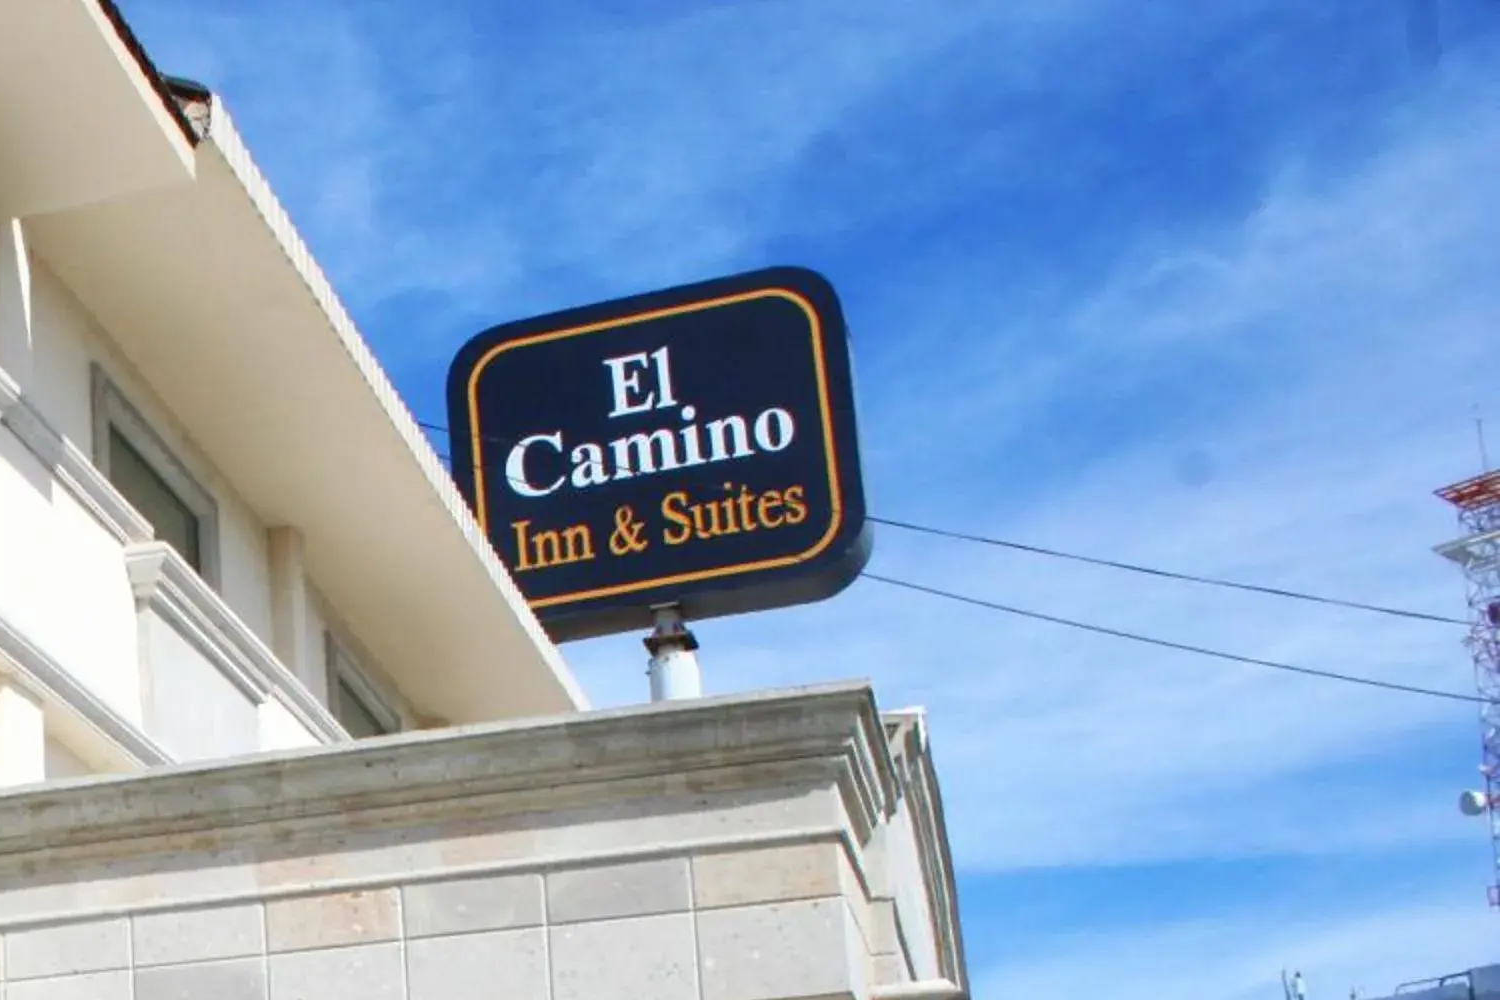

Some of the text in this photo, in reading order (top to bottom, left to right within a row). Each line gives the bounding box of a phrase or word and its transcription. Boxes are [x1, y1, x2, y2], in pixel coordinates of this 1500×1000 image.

[603, 346, 678, 418] El
[505, 405, 795, 497] Camino
[511, 482, 807, 572] Inn & Suites
